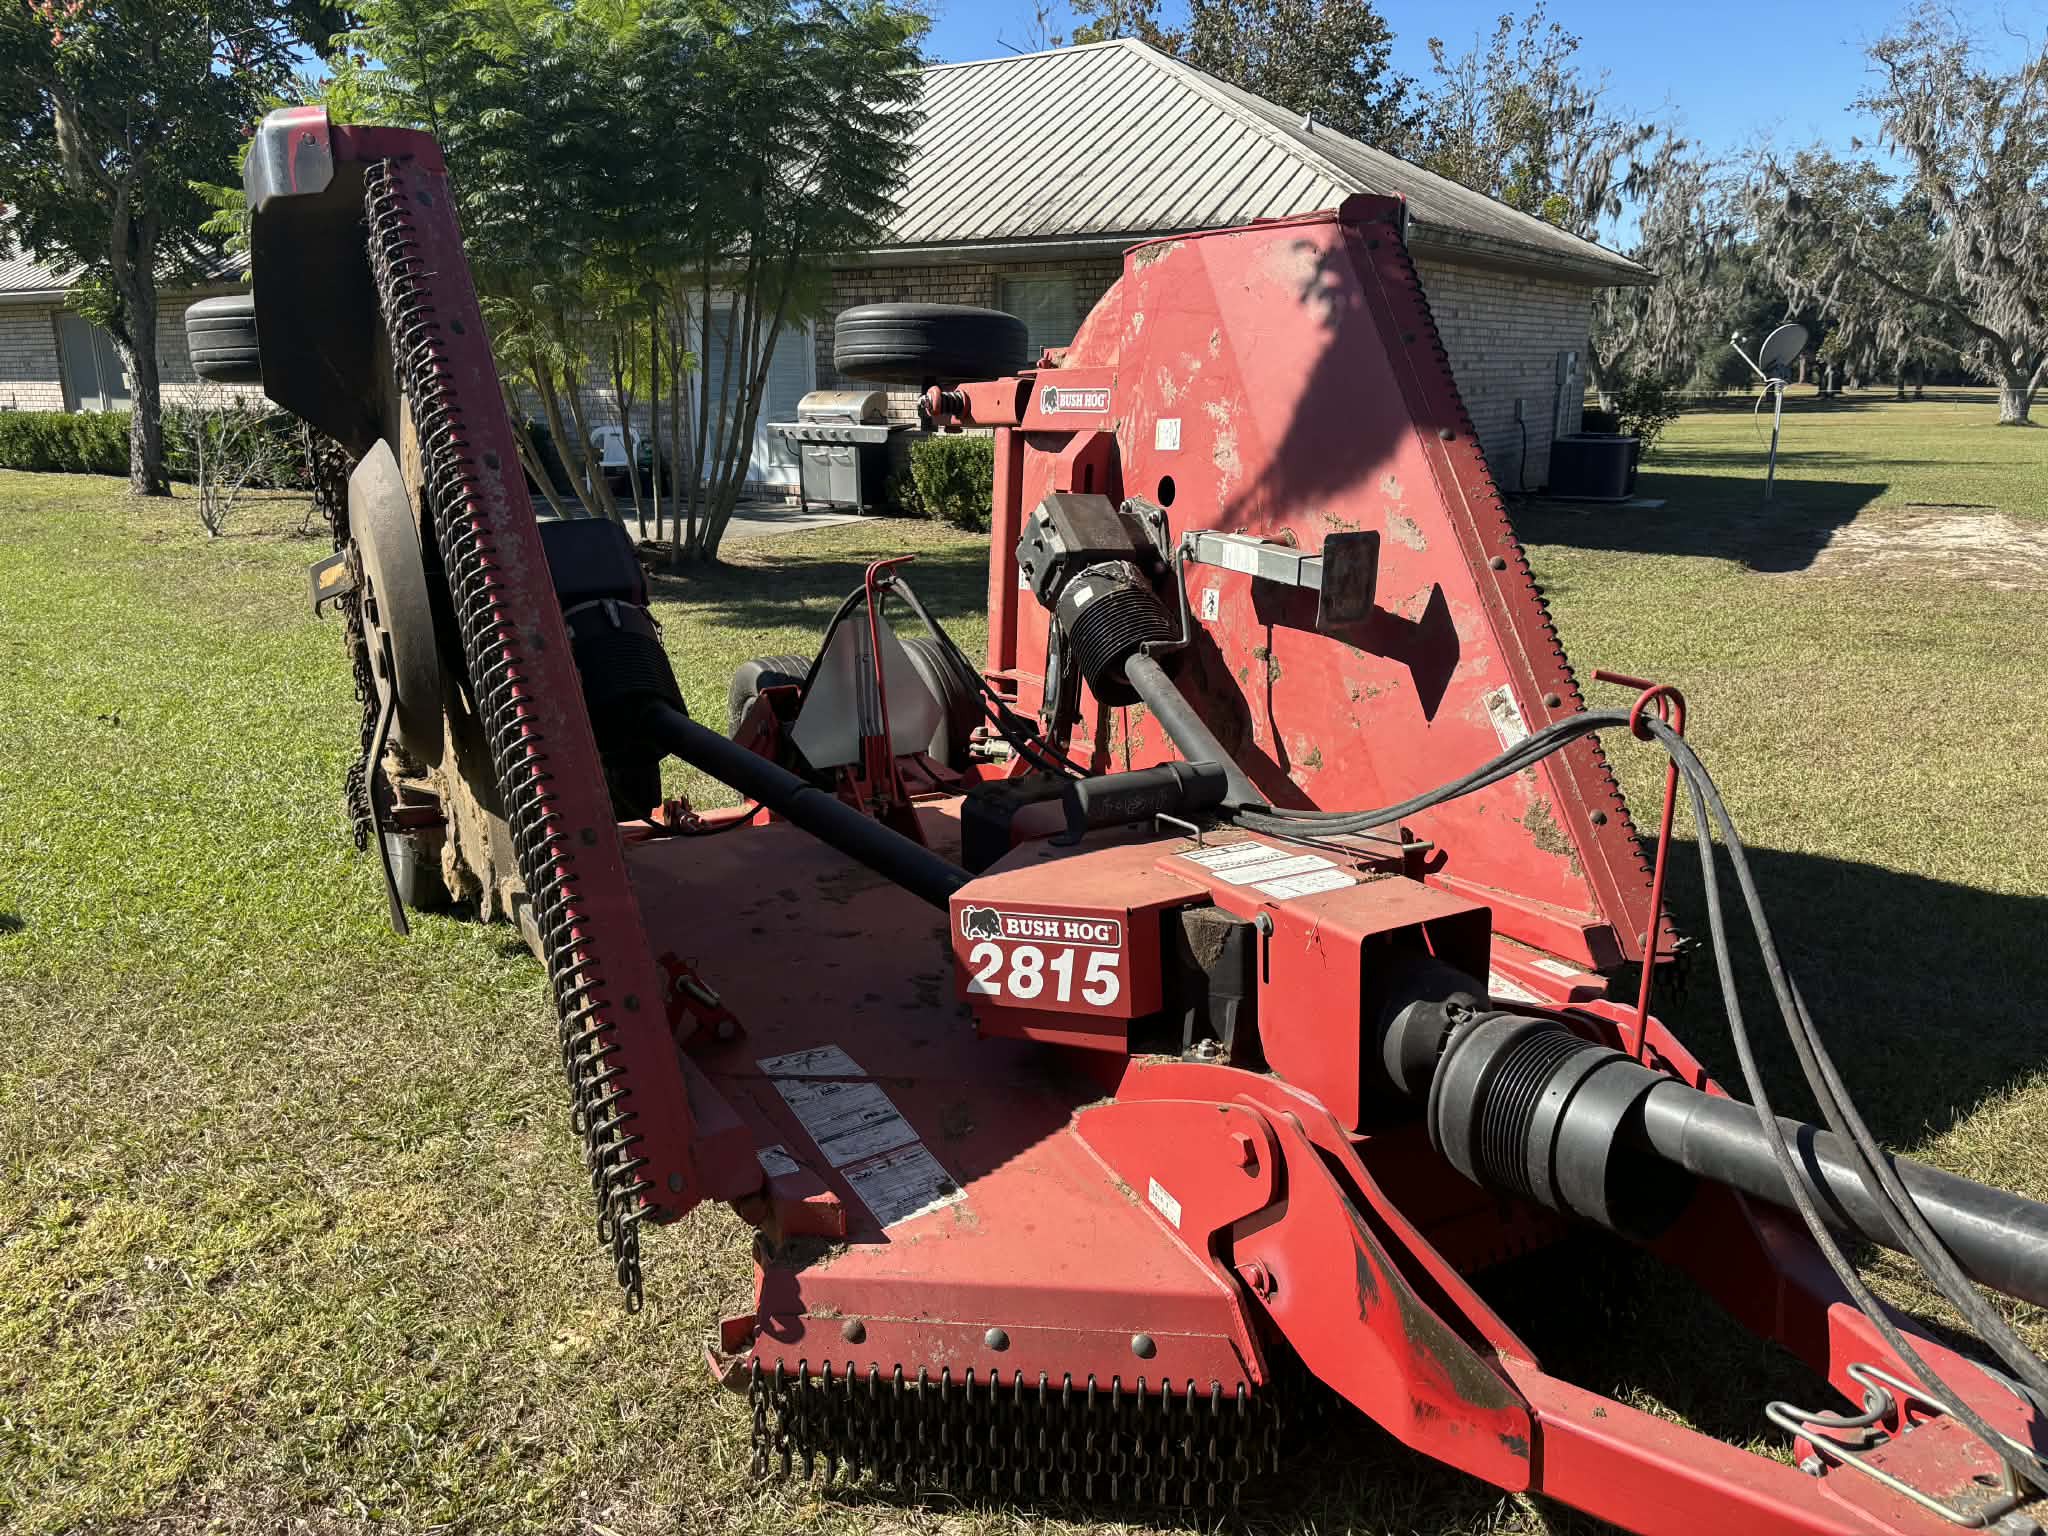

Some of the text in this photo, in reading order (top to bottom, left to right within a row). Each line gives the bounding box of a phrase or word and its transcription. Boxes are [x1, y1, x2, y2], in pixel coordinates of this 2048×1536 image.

[1059, 393, 1105, 408] BUSH HOG
[1006, 918, 1110, 942] BUSH HOG
[966, 942, 1120, 1006] 2815
